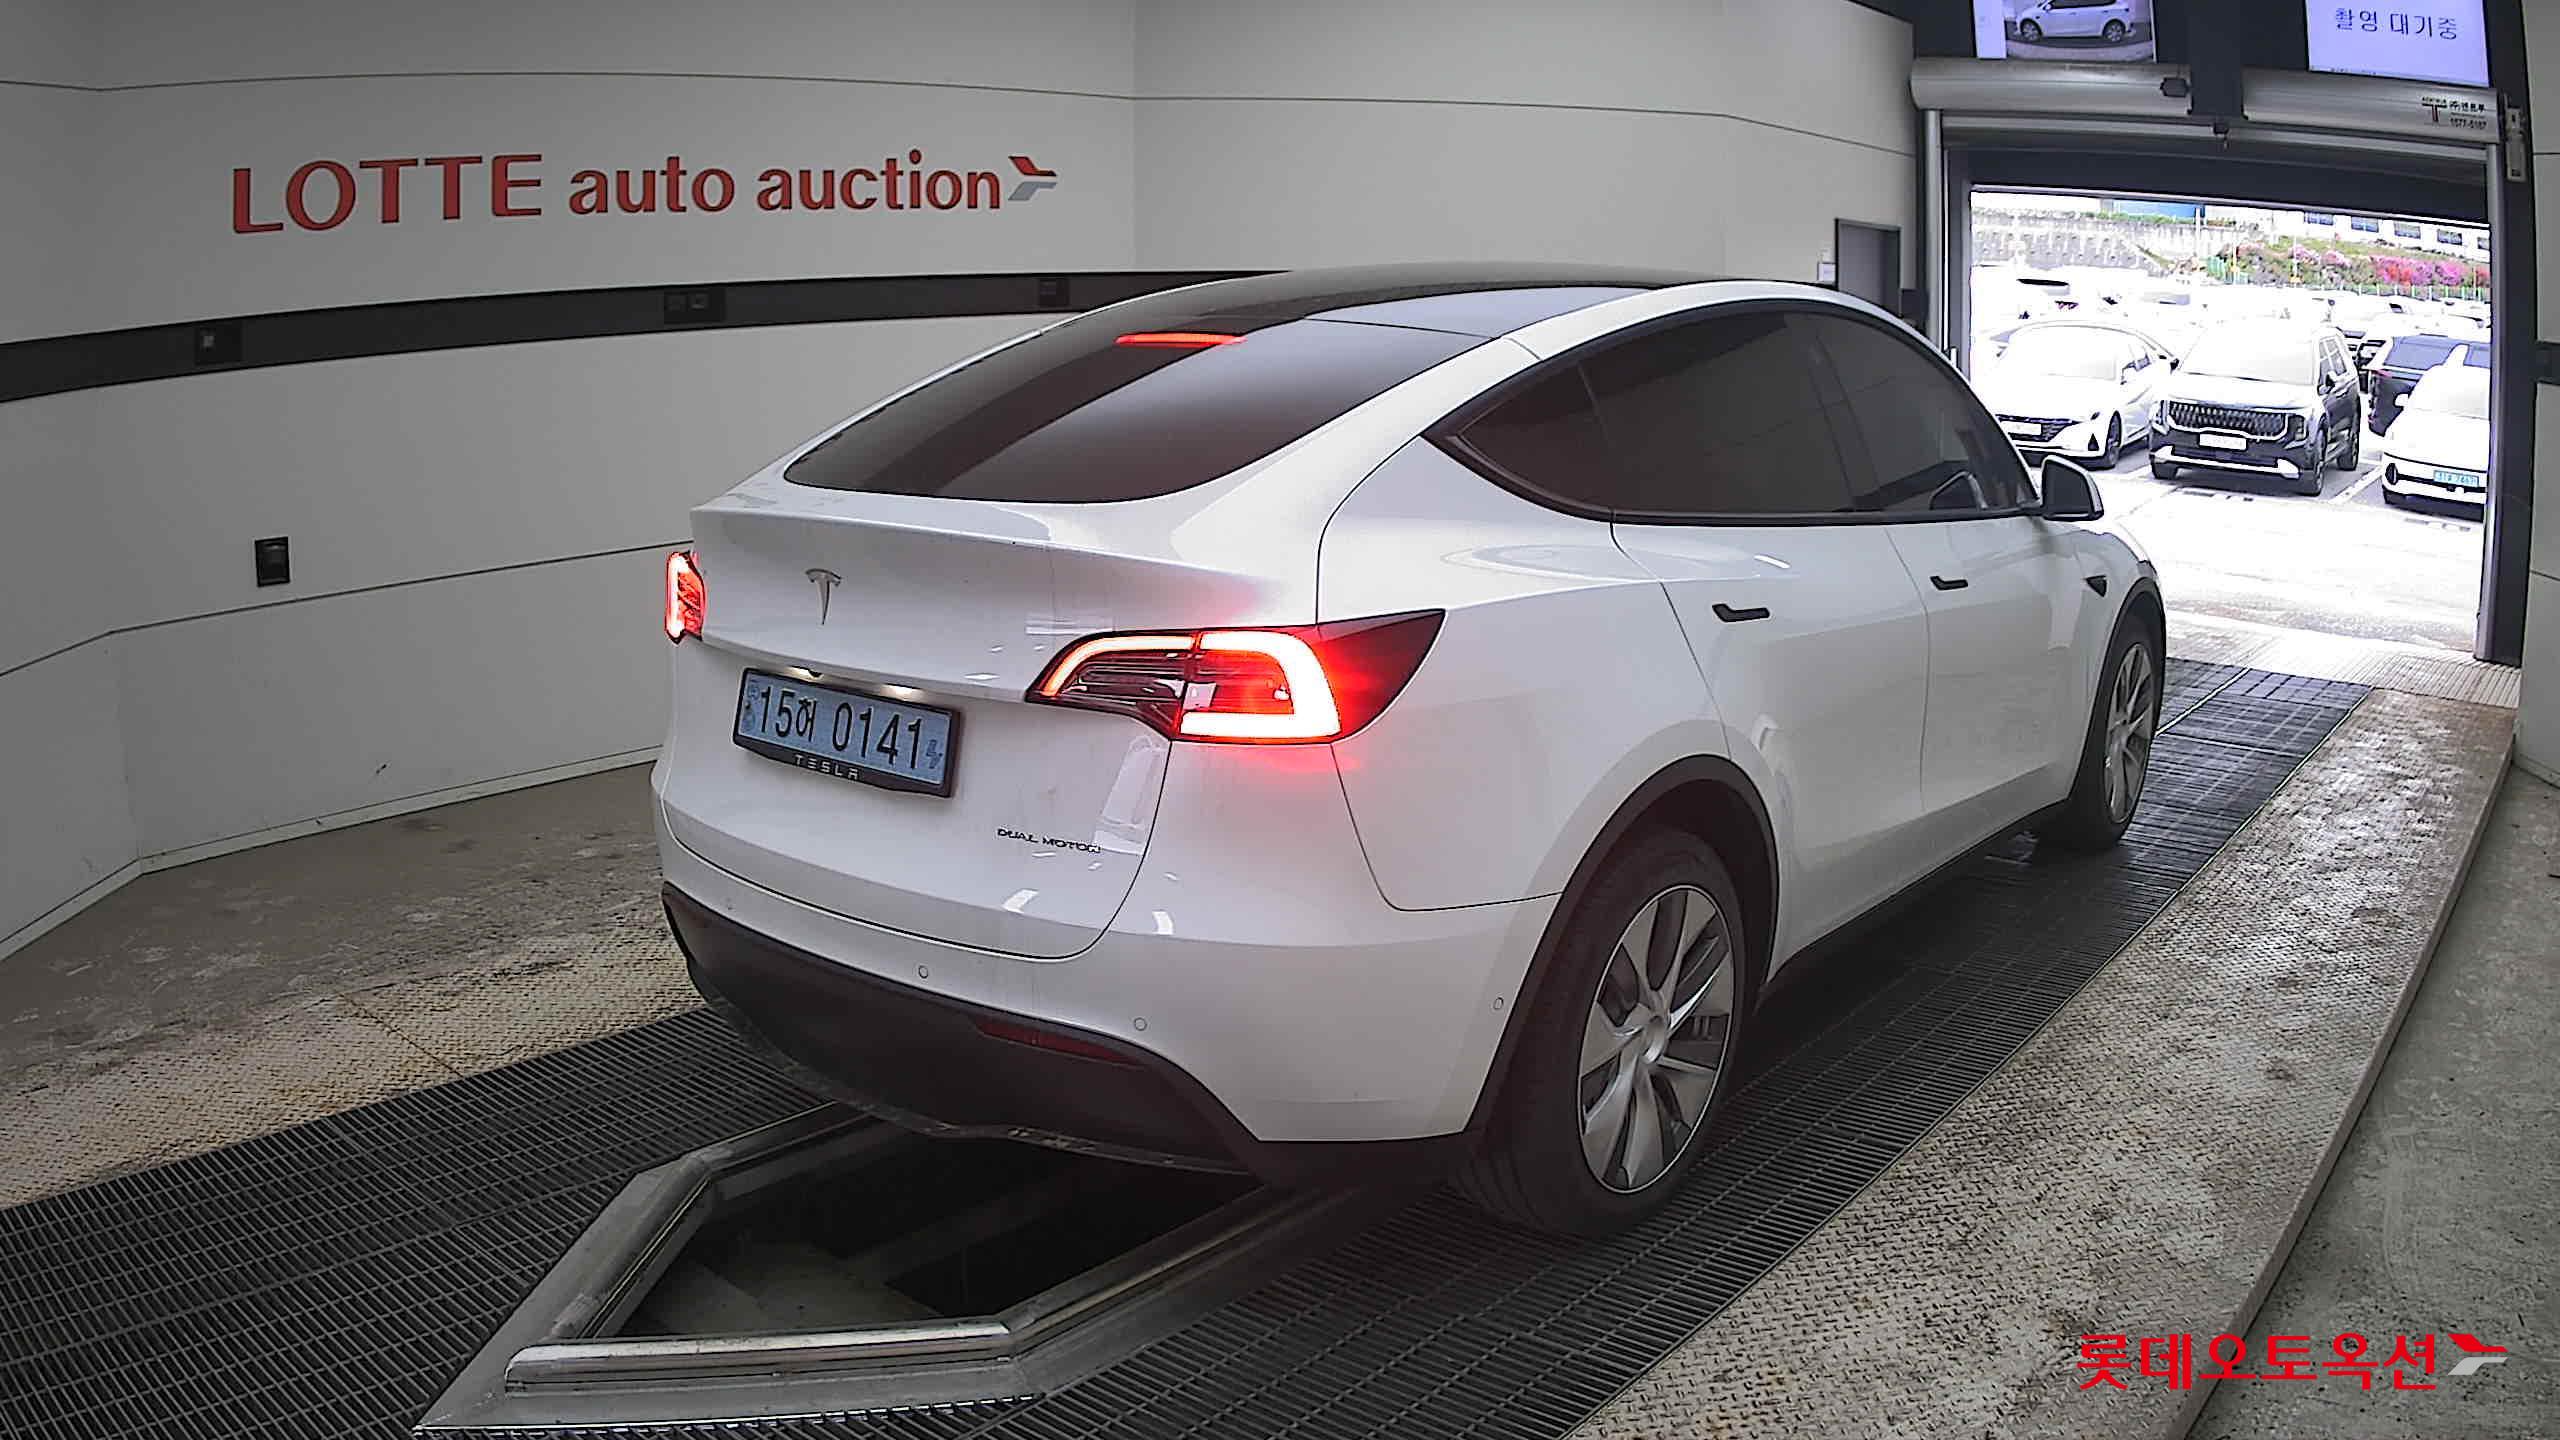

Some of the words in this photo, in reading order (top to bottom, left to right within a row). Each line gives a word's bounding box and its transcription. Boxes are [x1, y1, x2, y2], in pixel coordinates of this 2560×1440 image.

[2335, 8, 2378, 32] 촬영
[2390, 13, 2457, 40] 대기중
[233, 154, 543, 234] LOTTE
[568, 157, 735, 214] auto
[757, 149, 1001, 210] auction
[832, 702, 922, 770] 0141
[794, 754, 861, 781] TESLA
[997, 828, 1038, 843] DUAL
[1042, 837, 1101, 854] MOTOR
